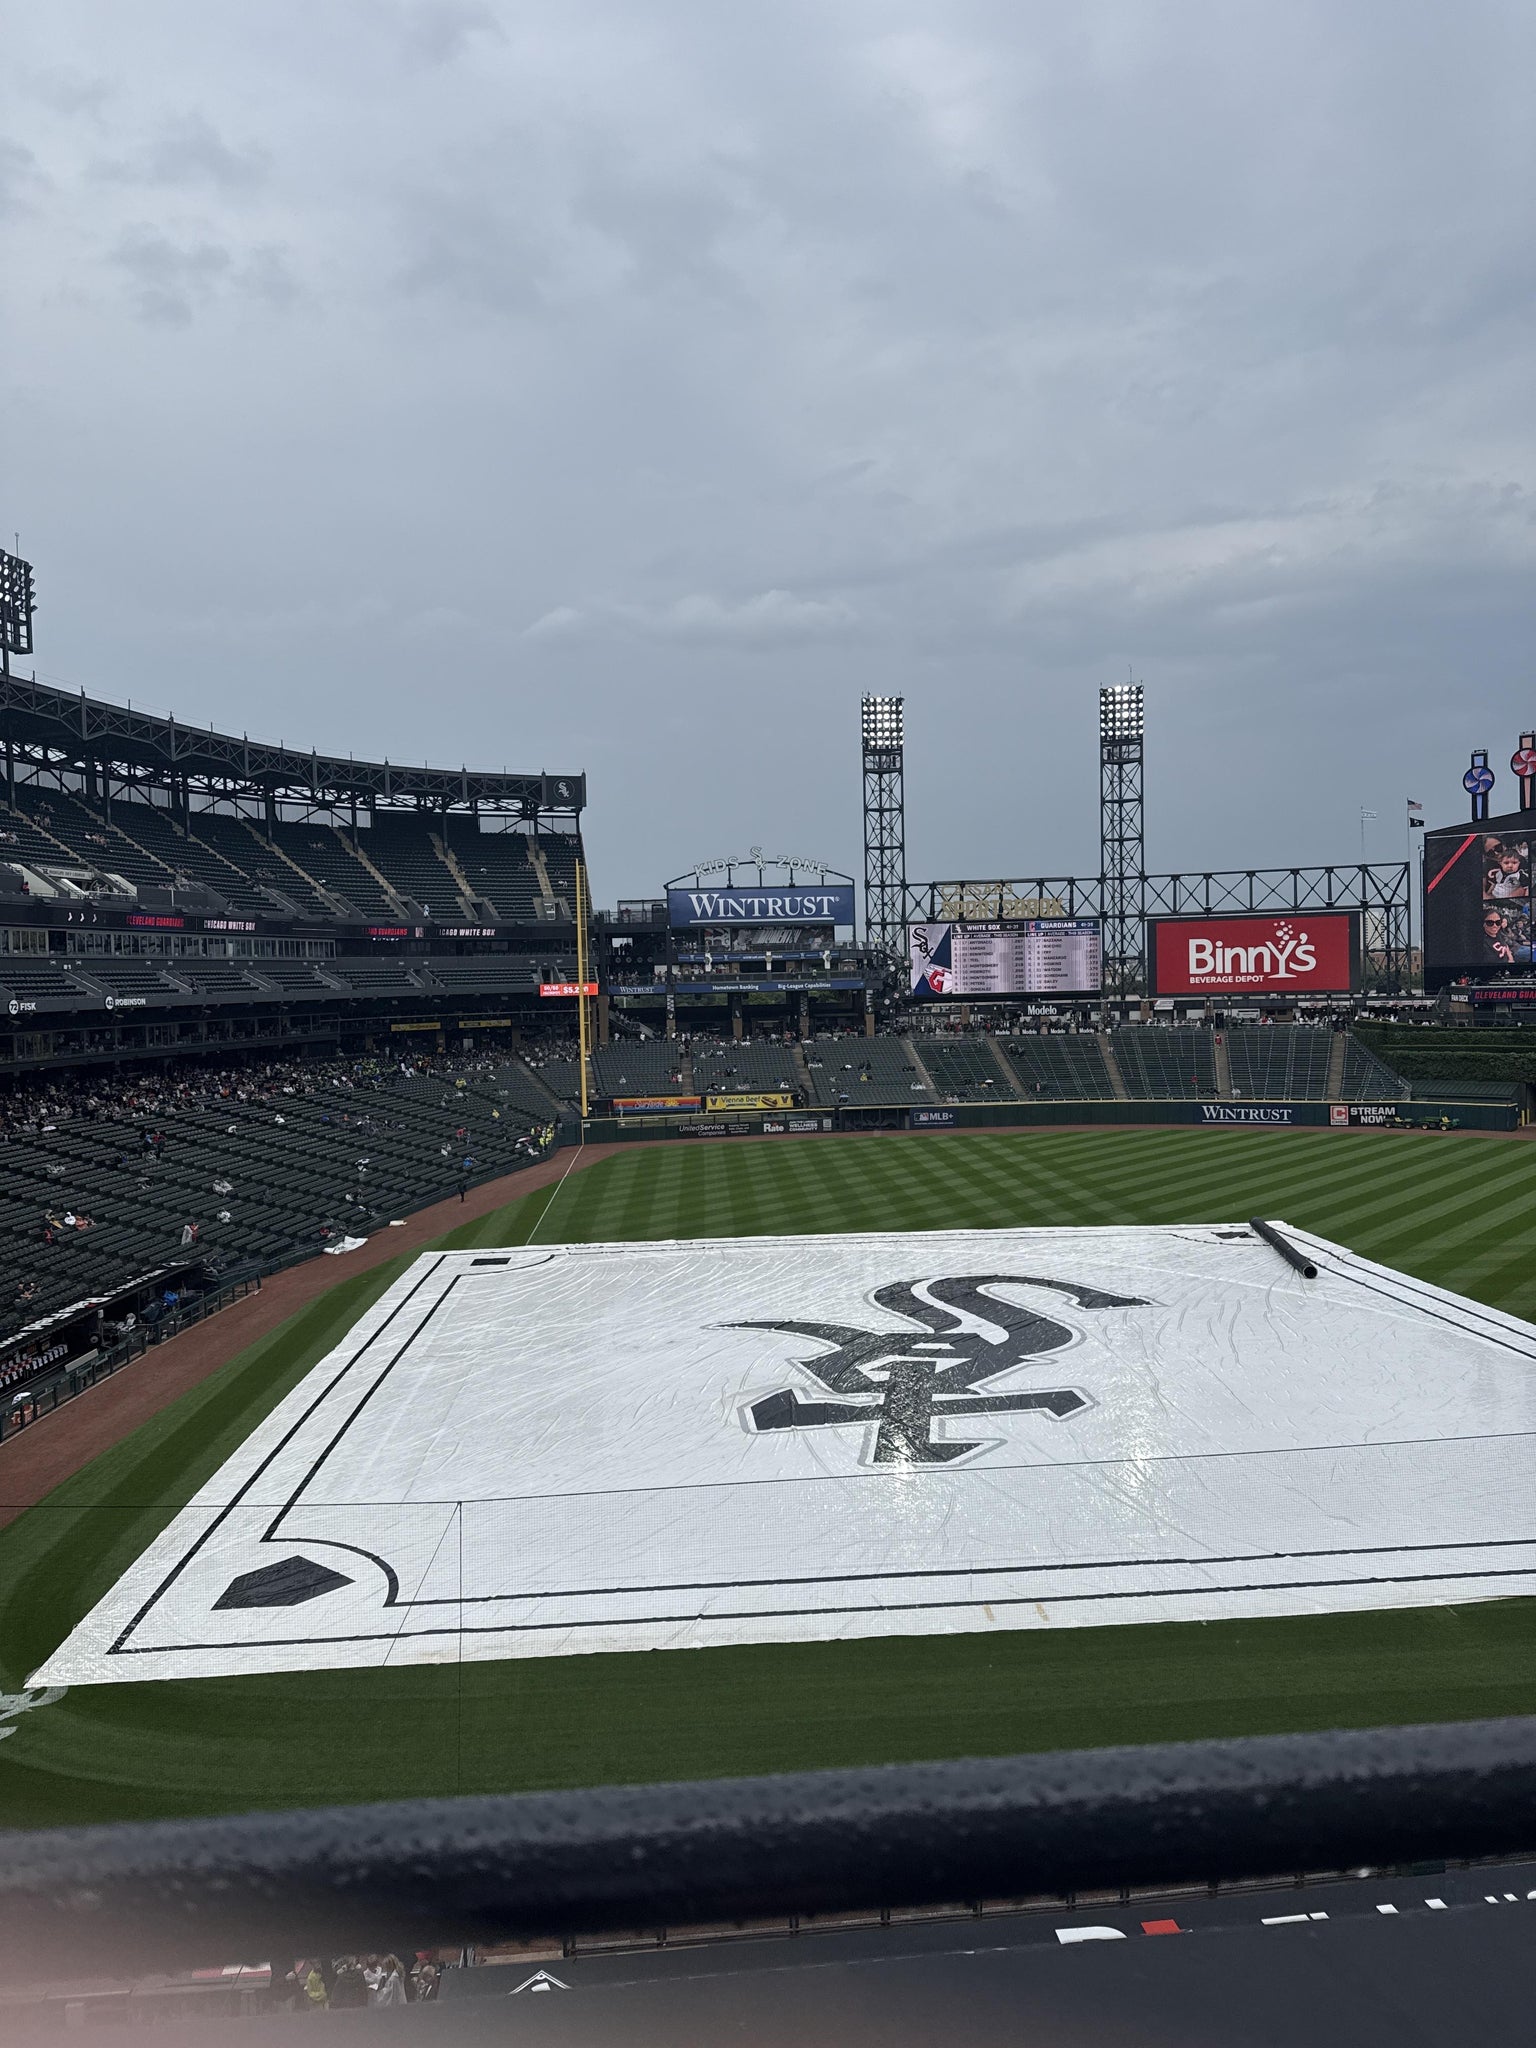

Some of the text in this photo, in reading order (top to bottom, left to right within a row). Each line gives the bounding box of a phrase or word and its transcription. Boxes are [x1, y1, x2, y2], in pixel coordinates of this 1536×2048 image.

[694, 856, 740, 878] KIDS
[776, 855, 829, 876] ZONE
[940, 883, 1014, 897] CAESARS
[941, 898, 1063, 919] SPORTSBOOK
[204, 920, 256, 931] CHICAGO WHITE SOX
[459, 928, 480, 936] WHITE
[482, 928, 496, 936] SOX
[1189, 975, 1264, 984] BEVERAGE DEPOT
[804, 982, 832, 990] Capabilities
[1459, 994, 1469, 1002] DECK
[1474, 991, 1517, 999] CLEVELAND
[20, 1002, 36, 1010] FISK
[115, 998, 146, 1006] ROBINSON
[1028, 1005, 1057, 1015] Modelo
[930, 1112, 954, 1120] MLB+
[1202, 1106, 1292, 1120] WINTRUST
[1350, 1107, 1396, 1116] STREAM
[1361, 1115, 1386, 1124] NOW
[764, 1122, 784, 1132] Rate
